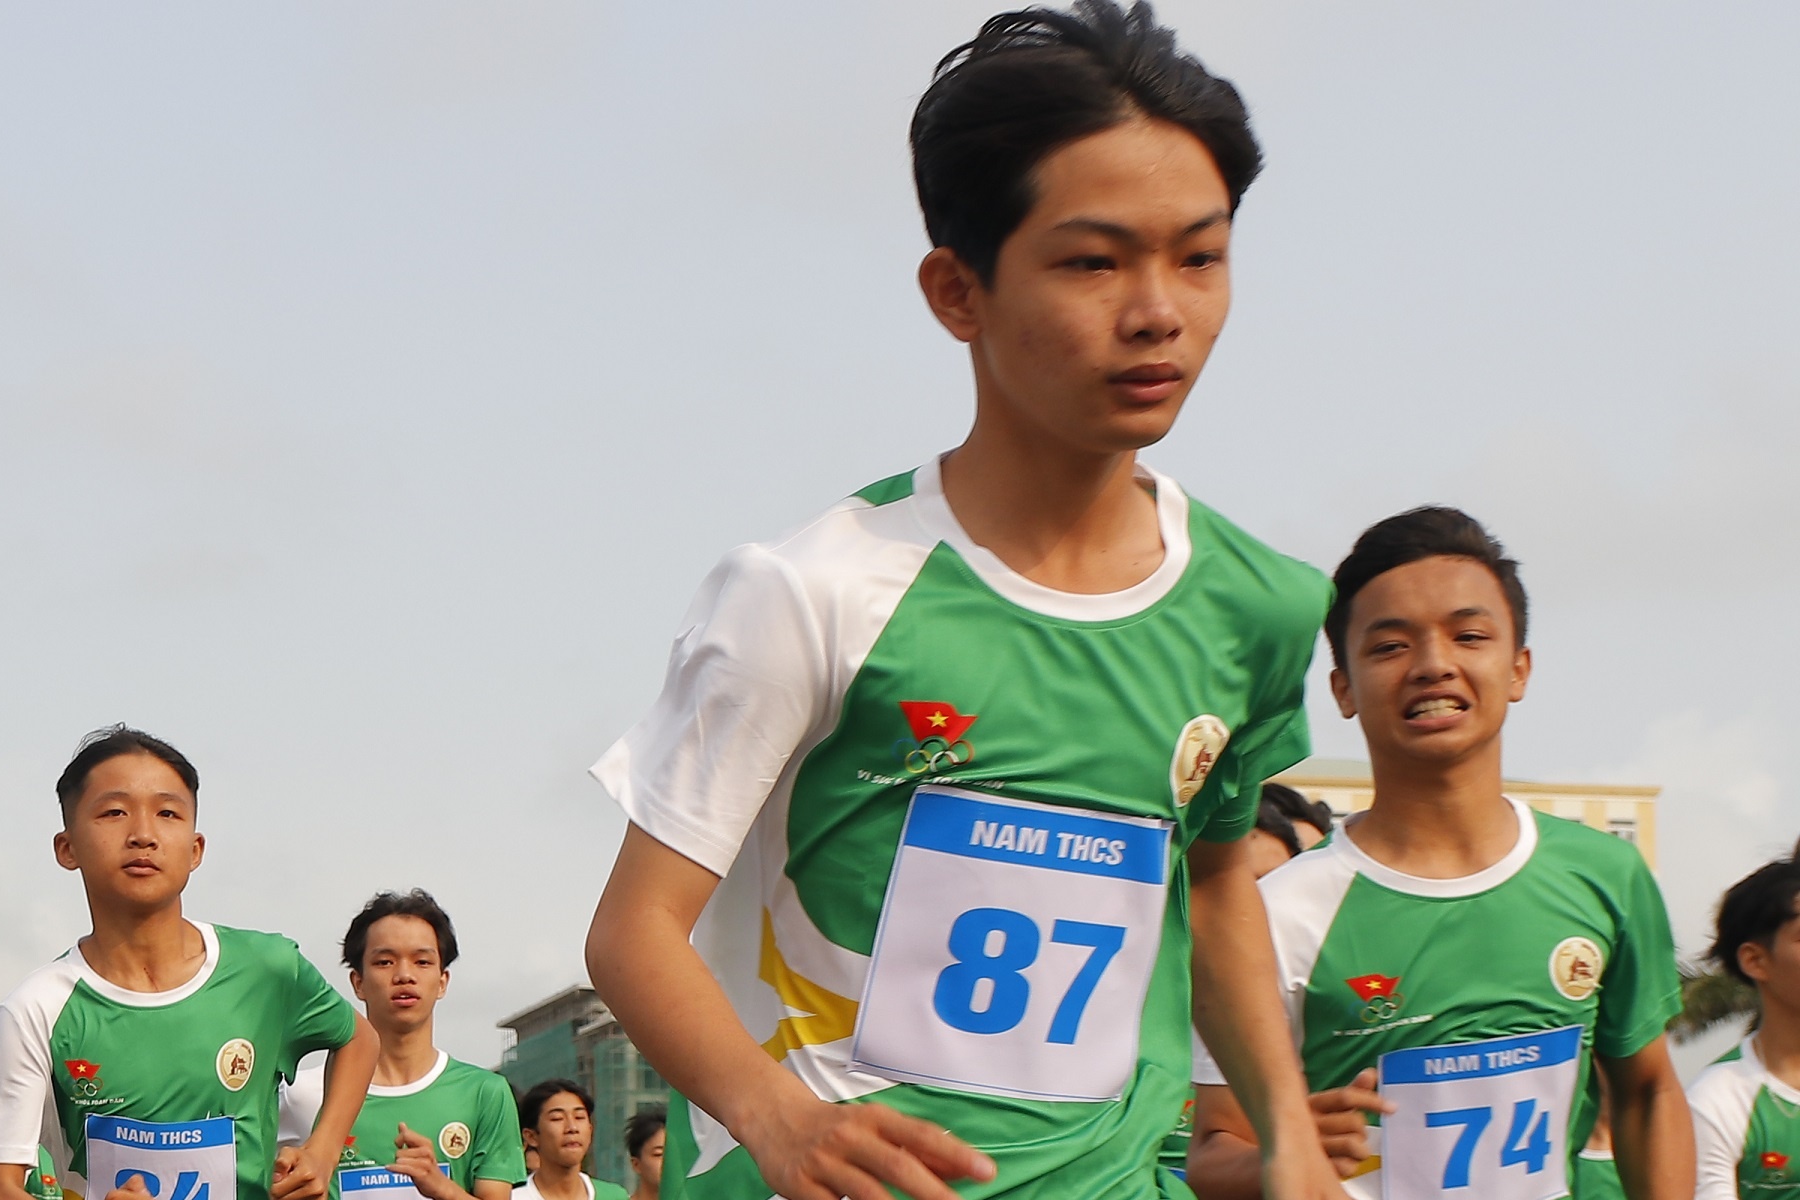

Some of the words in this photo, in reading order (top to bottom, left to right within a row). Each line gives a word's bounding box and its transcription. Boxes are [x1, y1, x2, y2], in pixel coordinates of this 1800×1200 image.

[969, 819, 1049, 856] NAM
[1056, 832, 1127, 866] THCS
[933, 907, 1128, 1045] 87
[1424, 1055, 1480, 1075] NAM
[1485, 1045, 1541, 1069] THCS
[116, 1126, 154, 1145] NAM
[160, 1129, 202, 1145] THCS
[1425, 1098, 1552, 1190] 74
[361, 1174, 390, 1186] NAM
